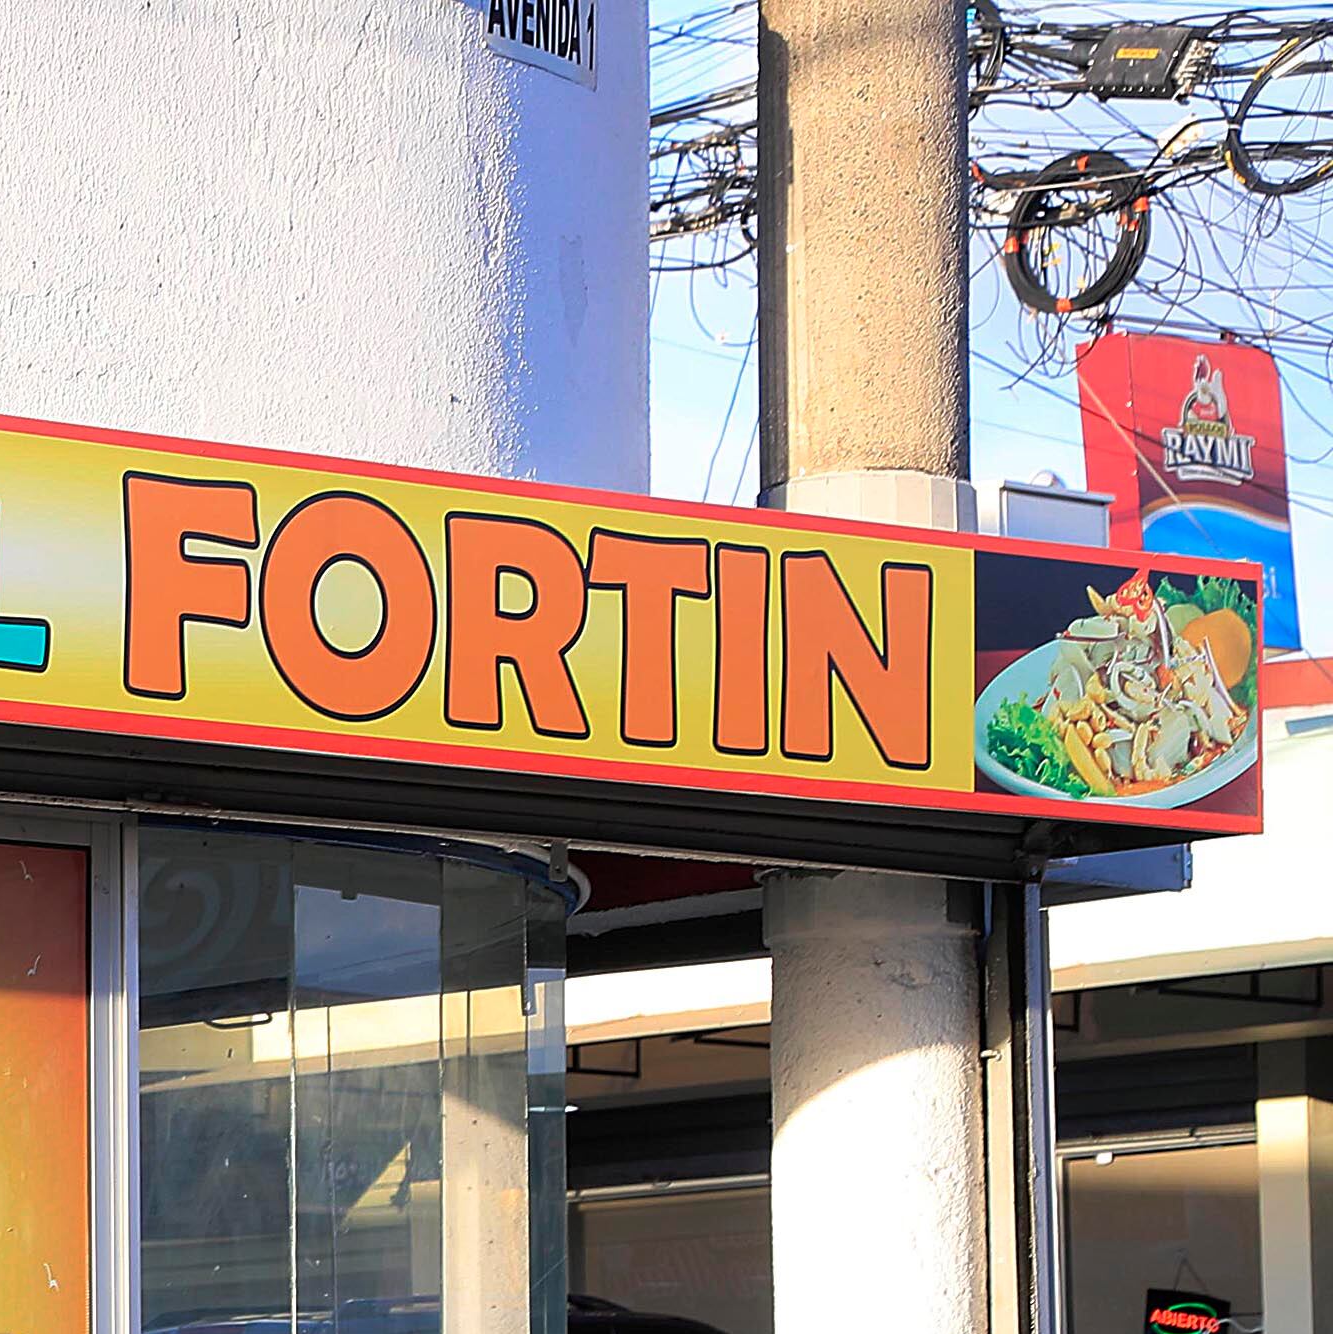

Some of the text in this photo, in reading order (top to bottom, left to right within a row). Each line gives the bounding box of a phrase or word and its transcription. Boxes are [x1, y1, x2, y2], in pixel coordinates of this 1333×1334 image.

[488, 0, 596, 71] AVENIDA 1
[1163, 430, 1254, 474] RAYMI
[122, 471, 932, 770] FORTIN
[1150, 1308, 1220, 1333] ABIERTO
